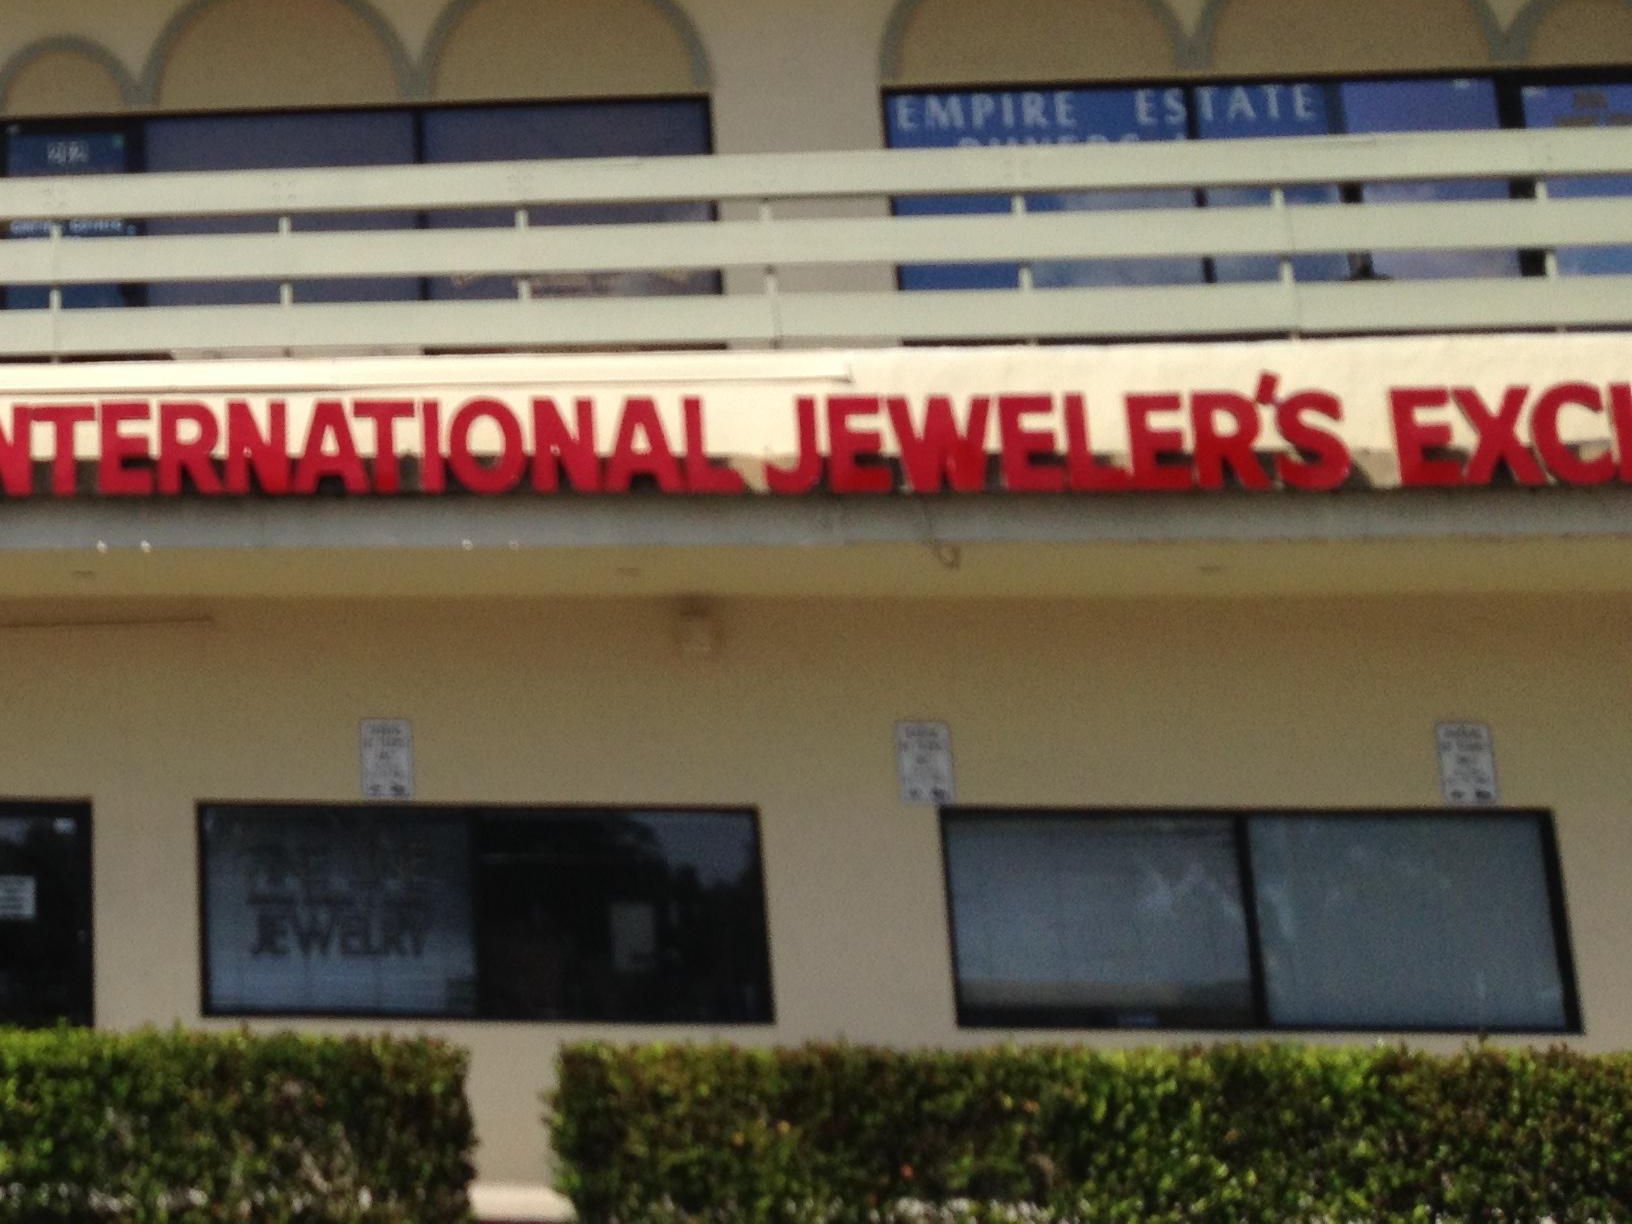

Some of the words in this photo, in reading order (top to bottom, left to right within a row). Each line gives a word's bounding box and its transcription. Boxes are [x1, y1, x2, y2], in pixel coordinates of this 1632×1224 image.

[895, 91, 1076, 131] EMPIRE
[1134, 82, 1319, 126] ESTATE
[761, 374, 1351, 493] JEWELER'S
